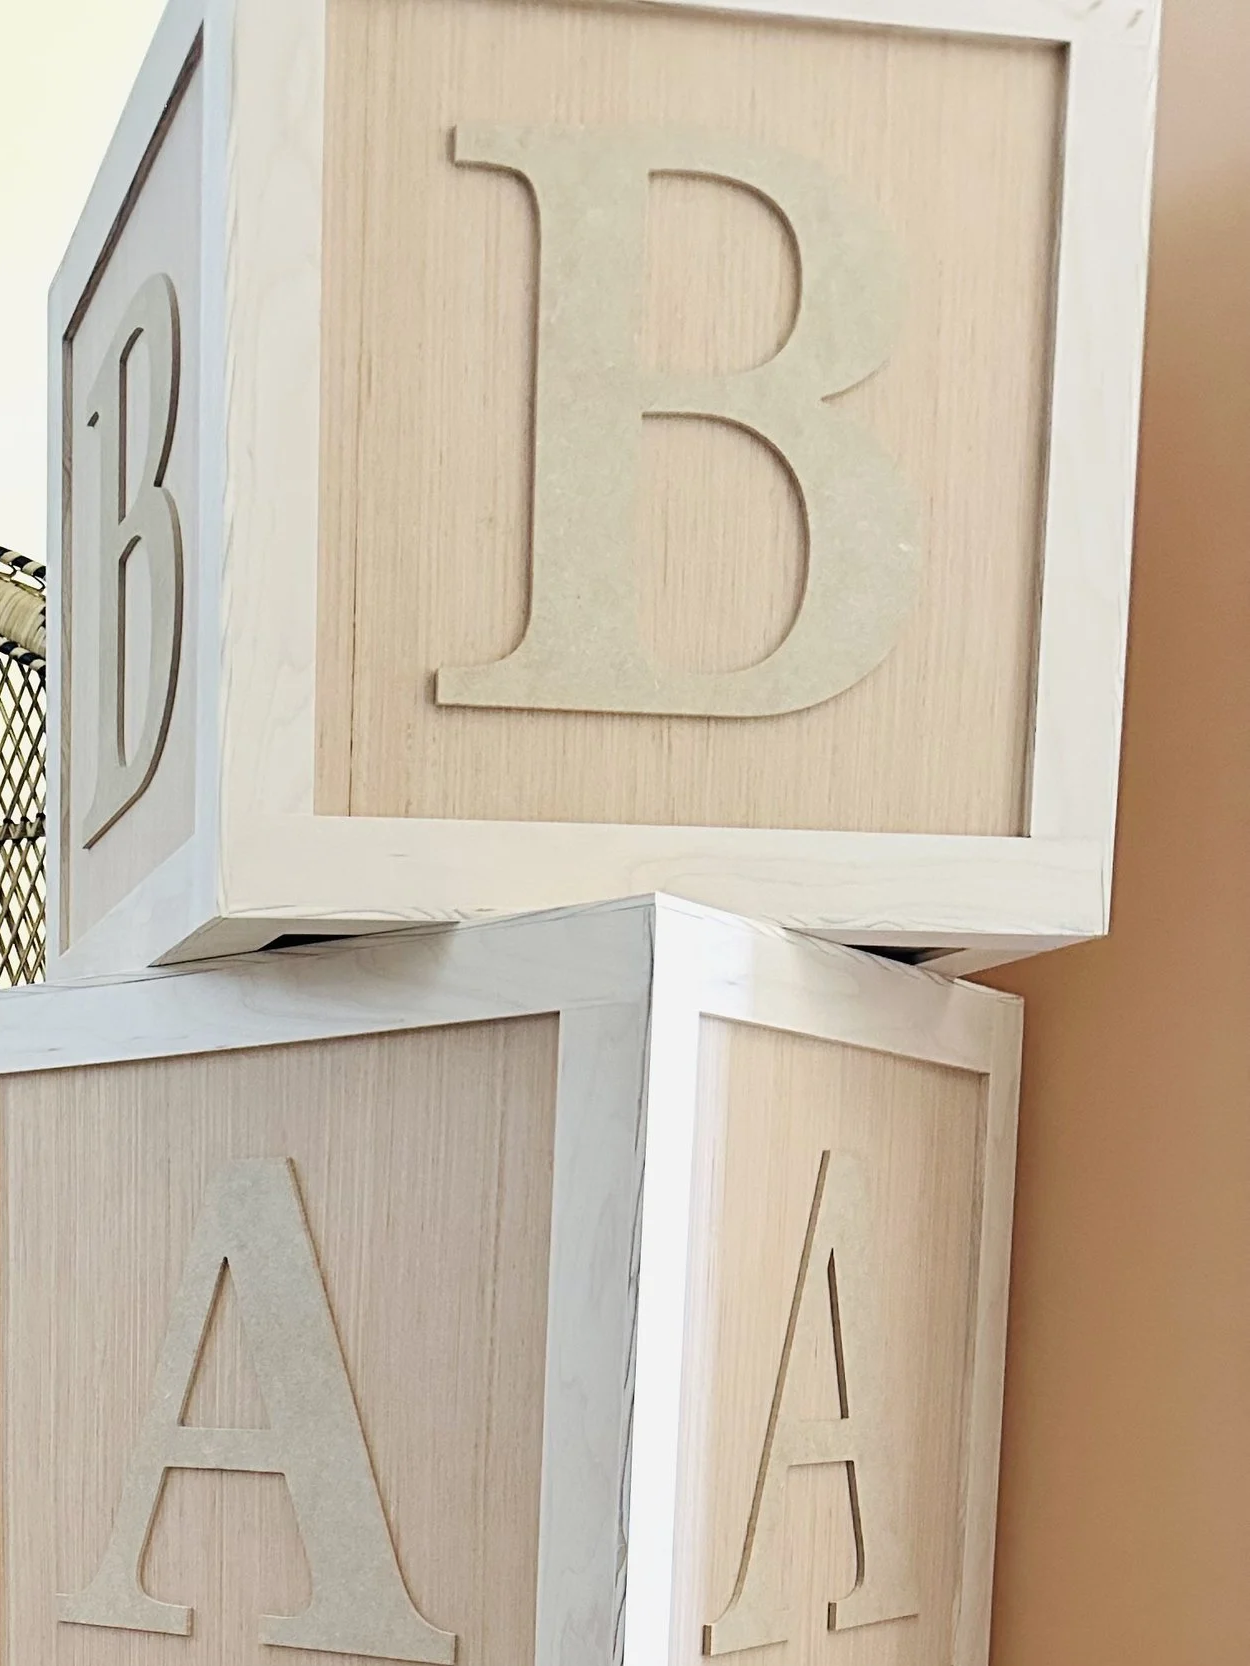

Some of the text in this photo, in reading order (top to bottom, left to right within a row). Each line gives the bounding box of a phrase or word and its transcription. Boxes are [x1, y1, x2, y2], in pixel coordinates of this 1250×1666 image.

[82, 272, 184, 850] B
[434, 123, 923, 717] B
[55, 1155, 458, 1665] A
[703, 1149, 919, 1657] A
